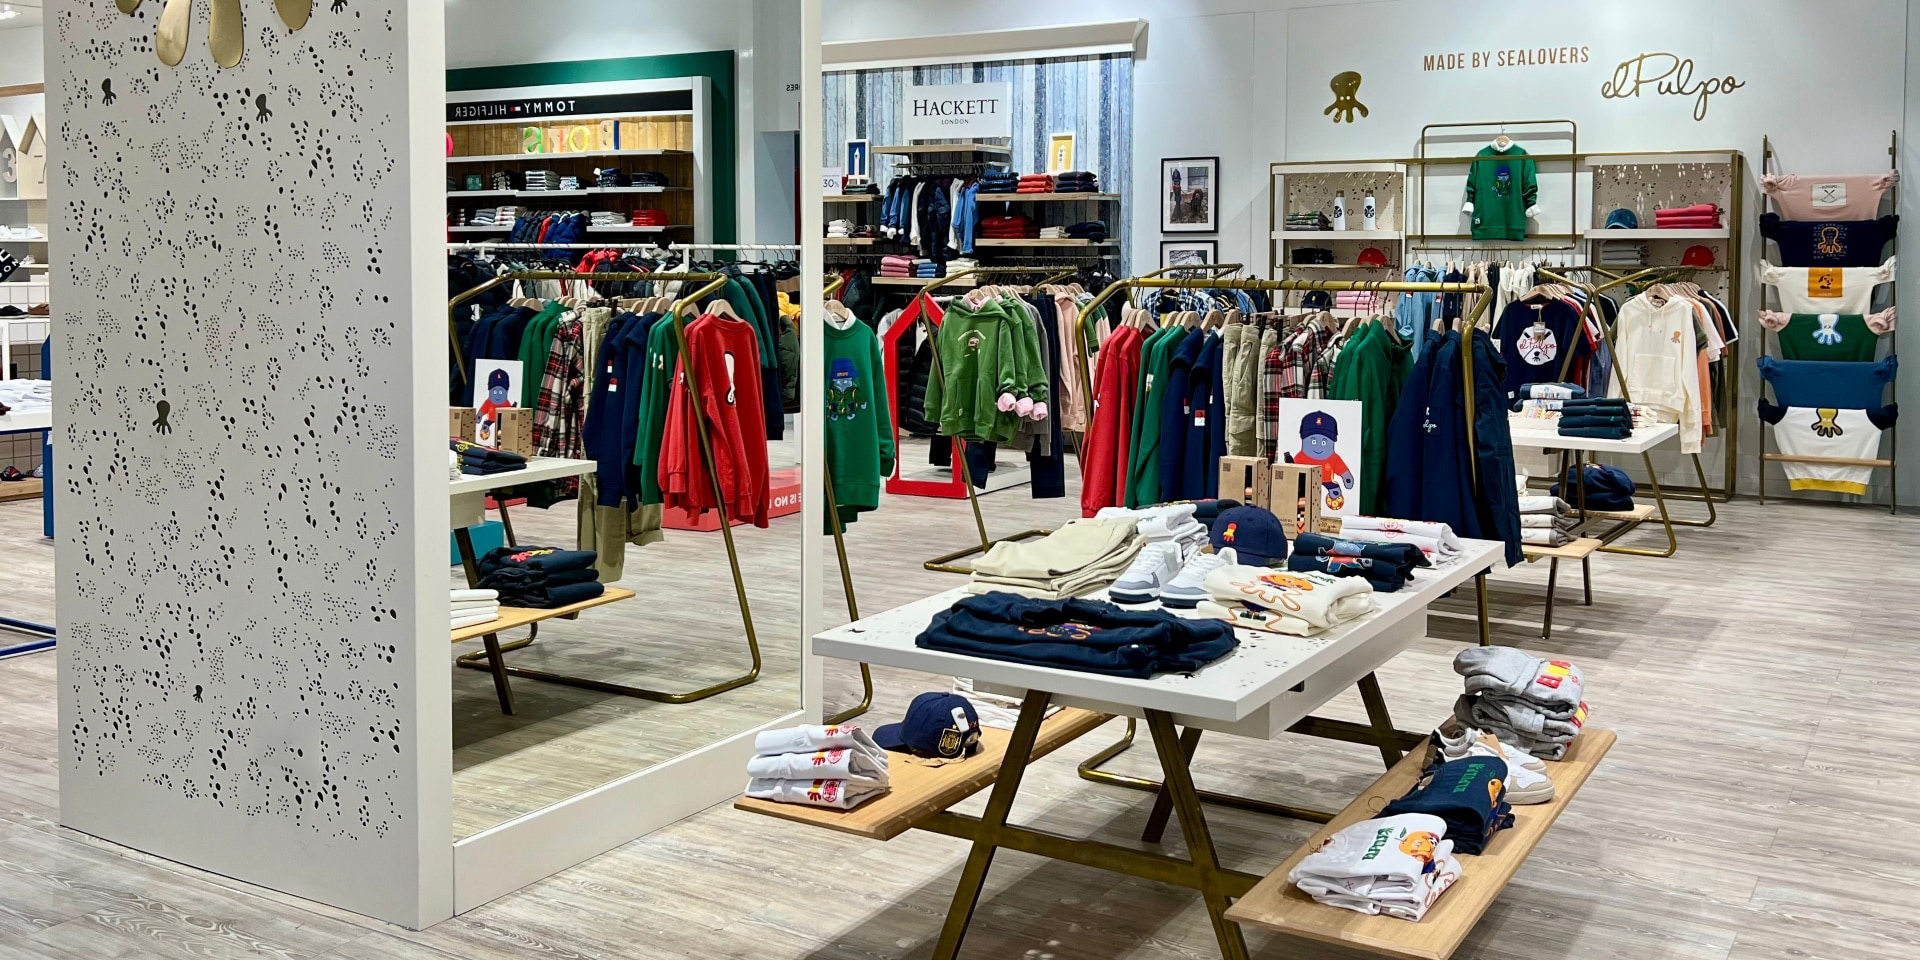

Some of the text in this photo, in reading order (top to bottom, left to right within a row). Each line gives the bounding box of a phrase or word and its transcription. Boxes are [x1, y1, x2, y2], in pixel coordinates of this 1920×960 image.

[1423, 46, 1590, 72] MADE BY SEALOVERS
[913, 98, 999, 117] HACKETT
[2, 147, 17, 183] 3
